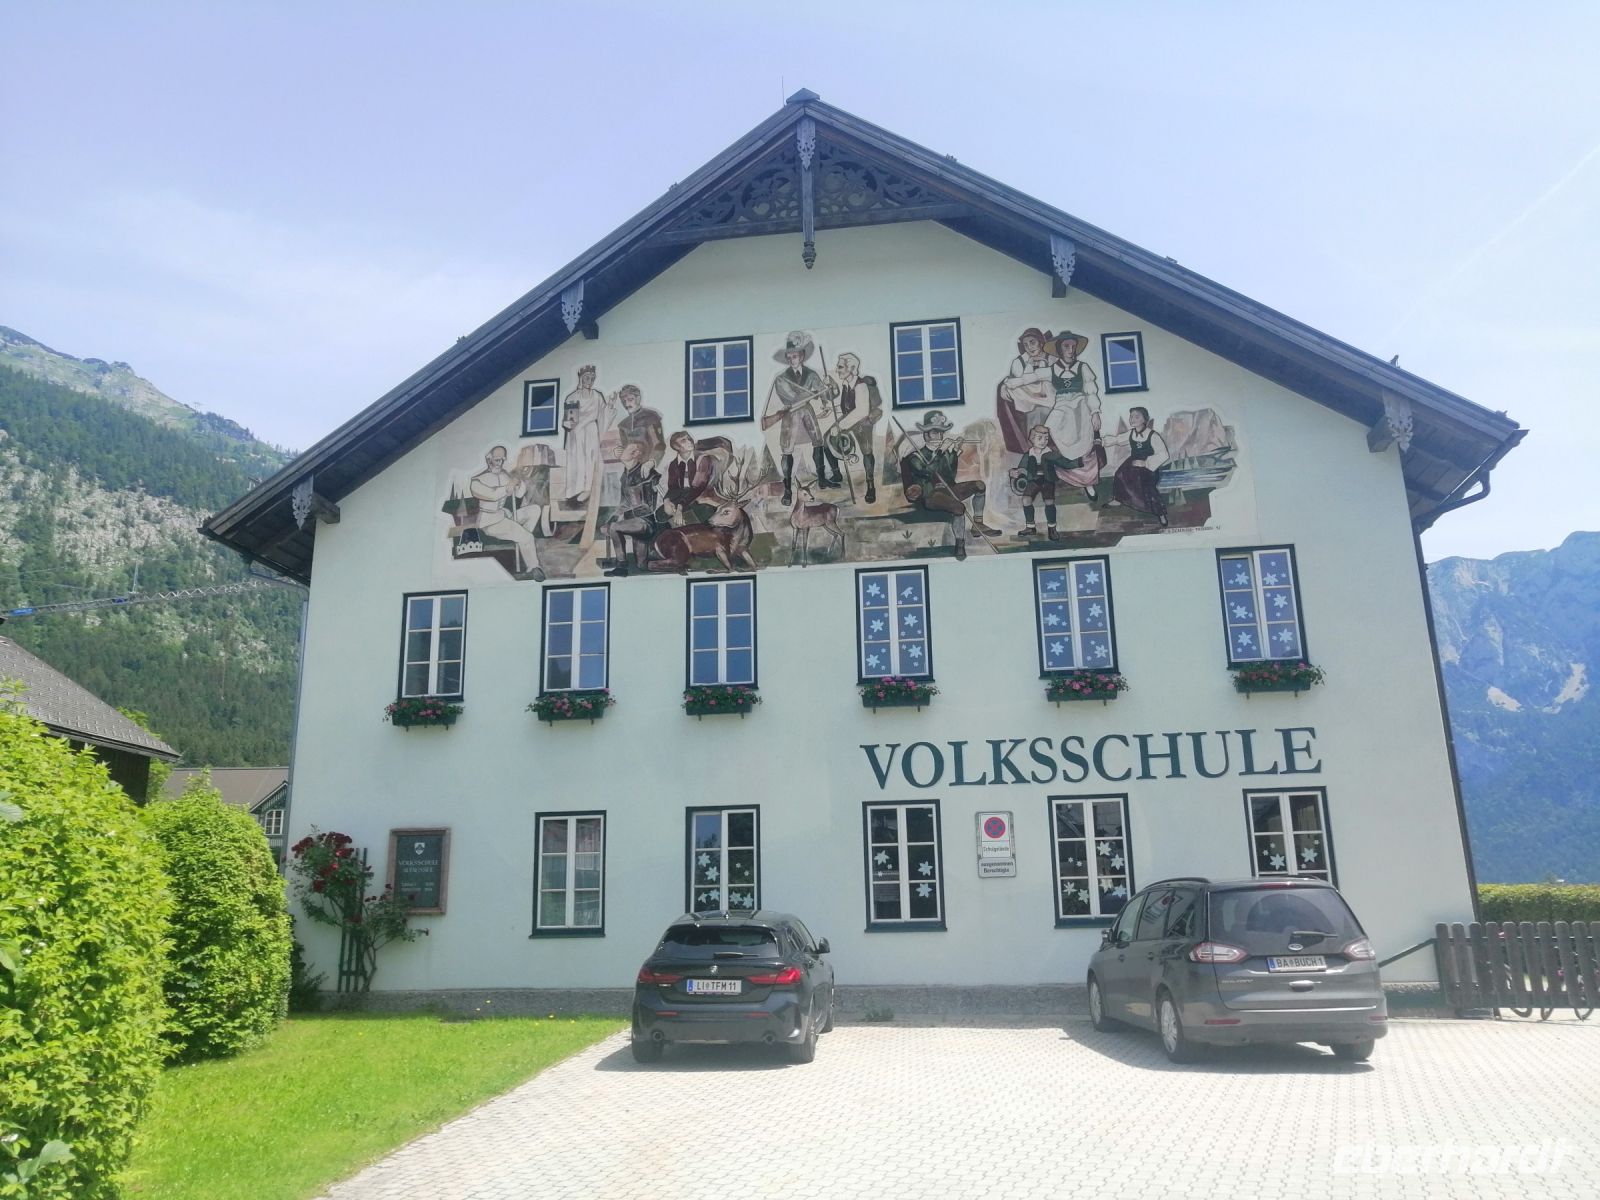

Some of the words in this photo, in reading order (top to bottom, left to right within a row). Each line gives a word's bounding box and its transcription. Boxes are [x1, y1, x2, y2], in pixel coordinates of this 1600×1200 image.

[859, 727, 1322, 789] VOLKSSCHULE
[1277, 958, 1290, 967] BA
[1295, 957, 1317, 967] BUCH
[1318, 958, 1323, 966] 1
[697, 981, 705, 990] LI
[711, 981, 727, 990] TFM
[728, 981, 736, 990] 11
